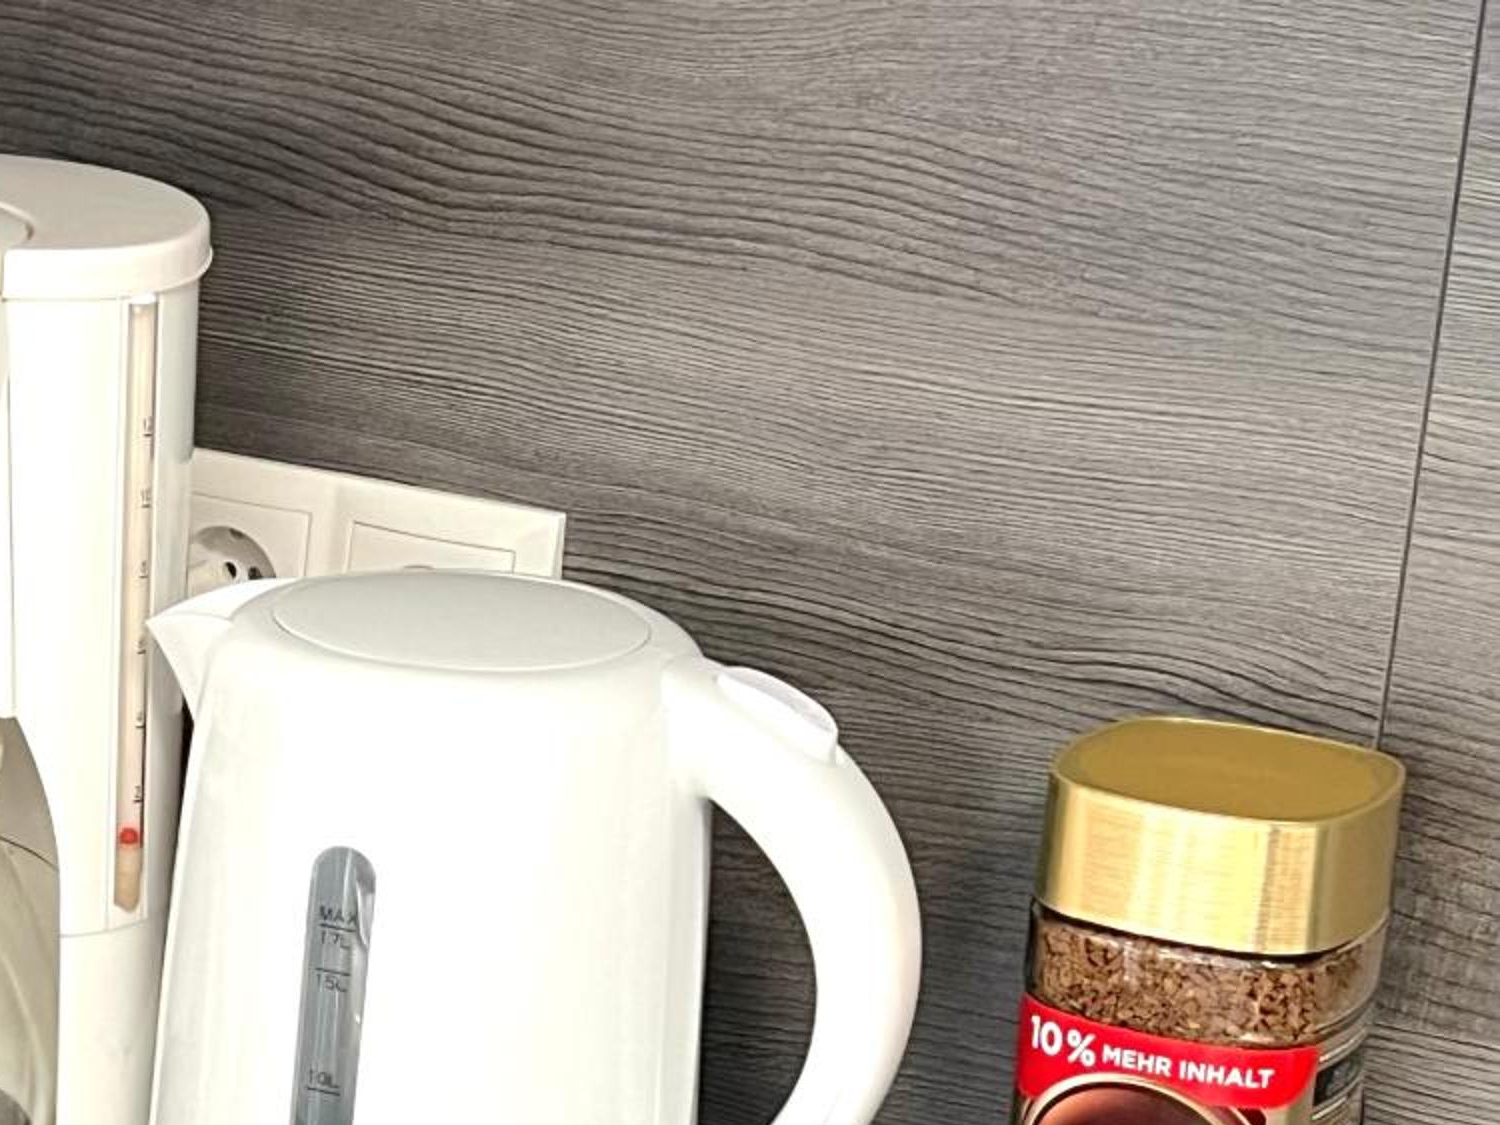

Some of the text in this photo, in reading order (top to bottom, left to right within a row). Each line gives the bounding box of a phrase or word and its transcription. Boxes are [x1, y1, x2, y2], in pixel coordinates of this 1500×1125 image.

[319, 905, 357, 926] MAX
[1030, 1015, 1276, 1089] 10% MEHR INHALT
